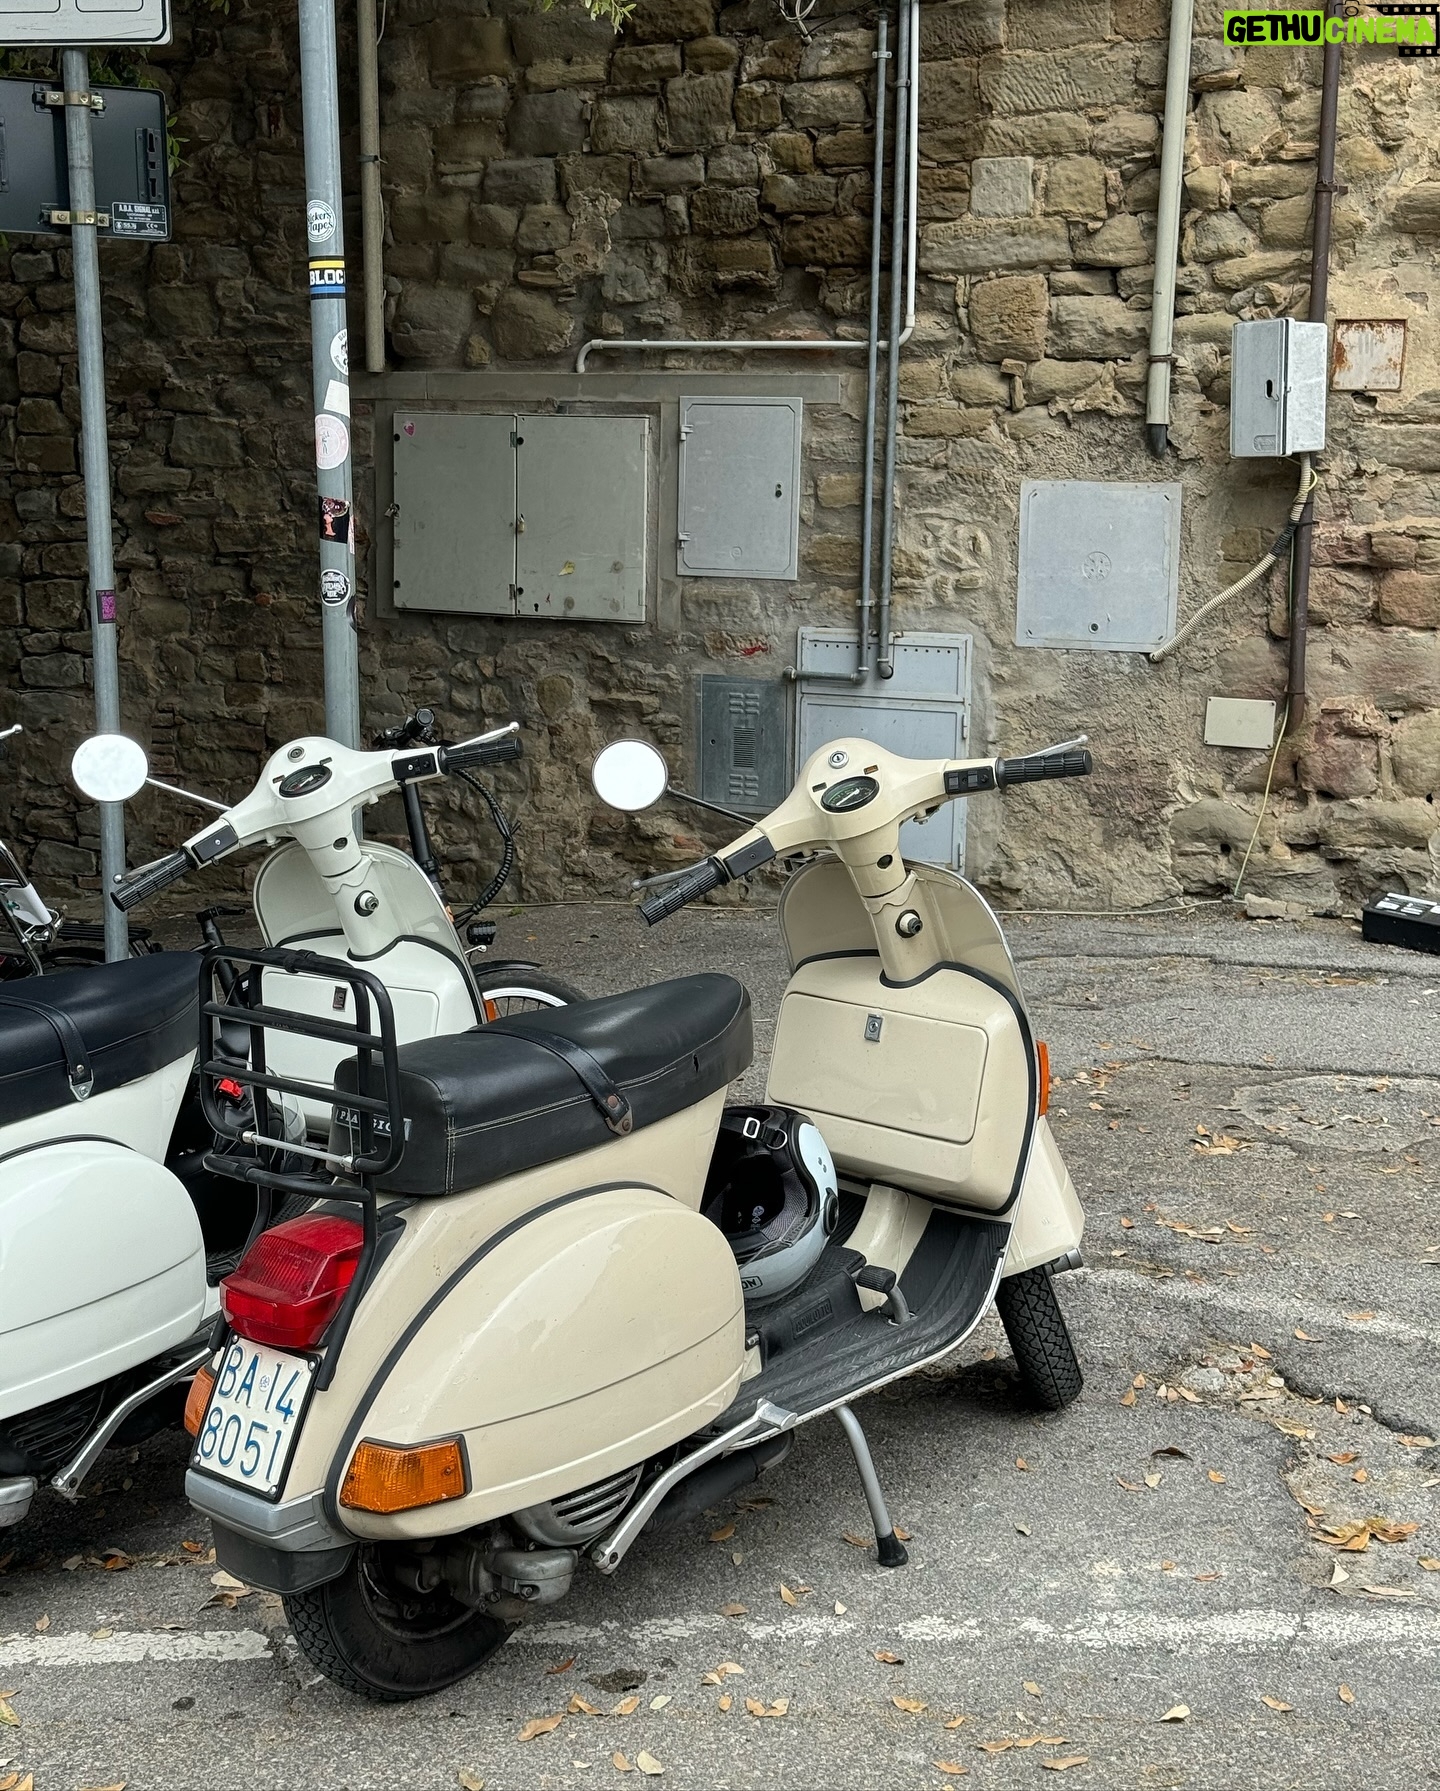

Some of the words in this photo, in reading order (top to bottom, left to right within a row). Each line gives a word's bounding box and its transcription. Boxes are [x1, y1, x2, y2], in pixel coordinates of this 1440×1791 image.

[309, 269, 345, 286] BLOC
[218, 1345, 260, 1408] BA
[265, 1361, 302, 1423] 14
[200, 1407, 282, 1482] 8051
